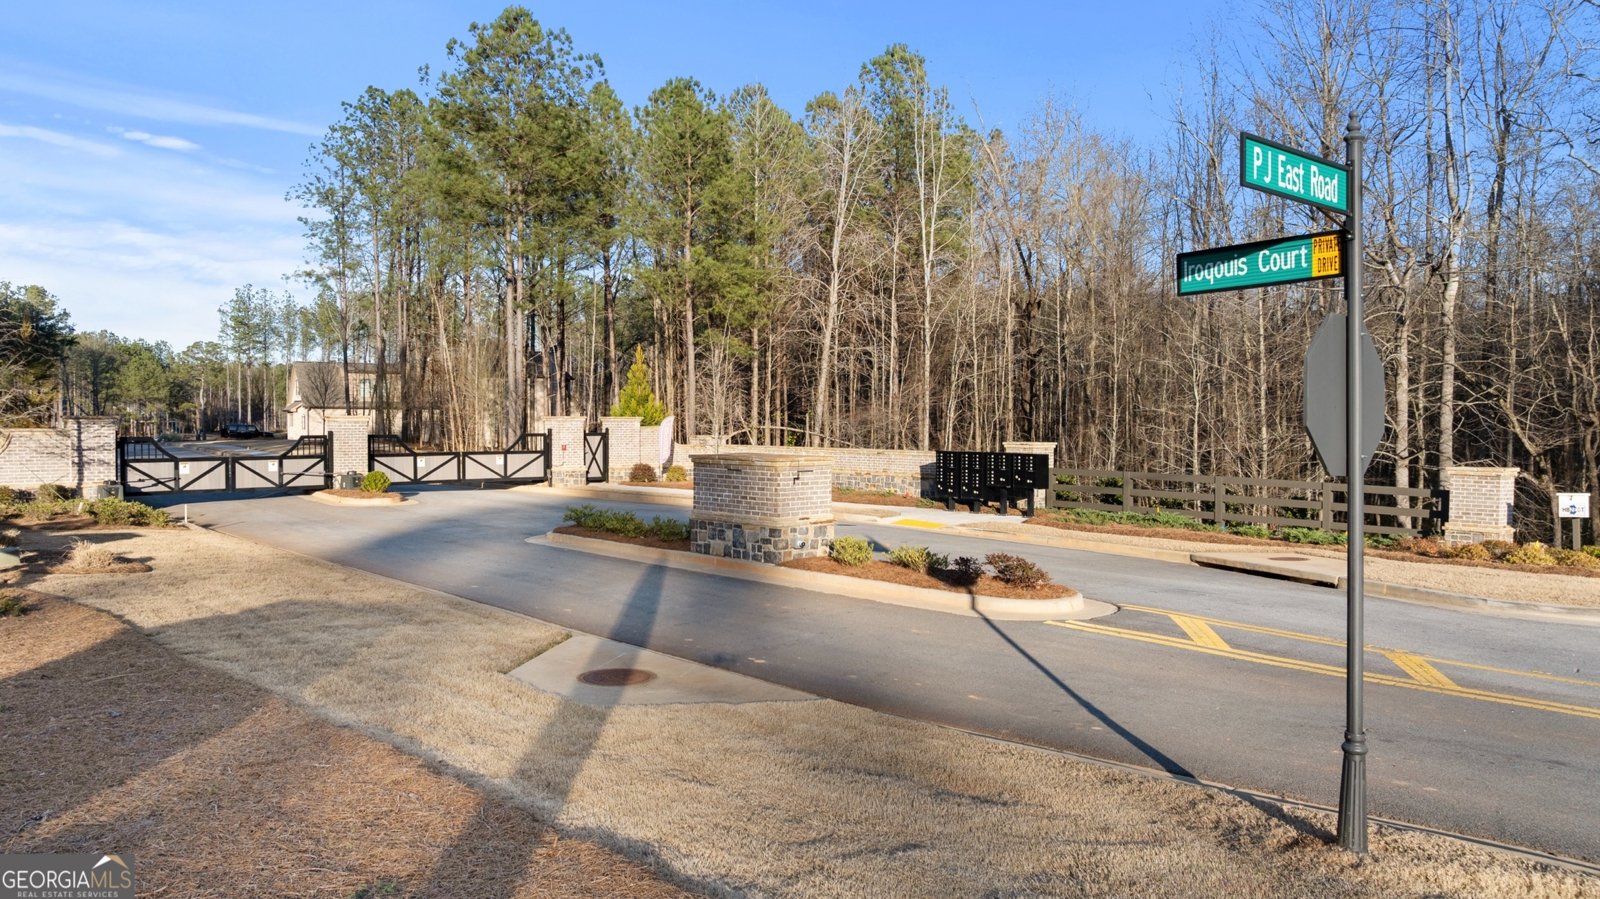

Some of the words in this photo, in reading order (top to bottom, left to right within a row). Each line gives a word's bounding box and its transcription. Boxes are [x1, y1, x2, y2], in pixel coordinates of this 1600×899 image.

[1277, 154, 1304, 194] East
[1310, 165, 1338, 203] Road
[1183, 254, 1248, 285] Iroqouis
[1258, 246, 1308, 272] Court
[1317, 255, 1338, 273] DRIVE
